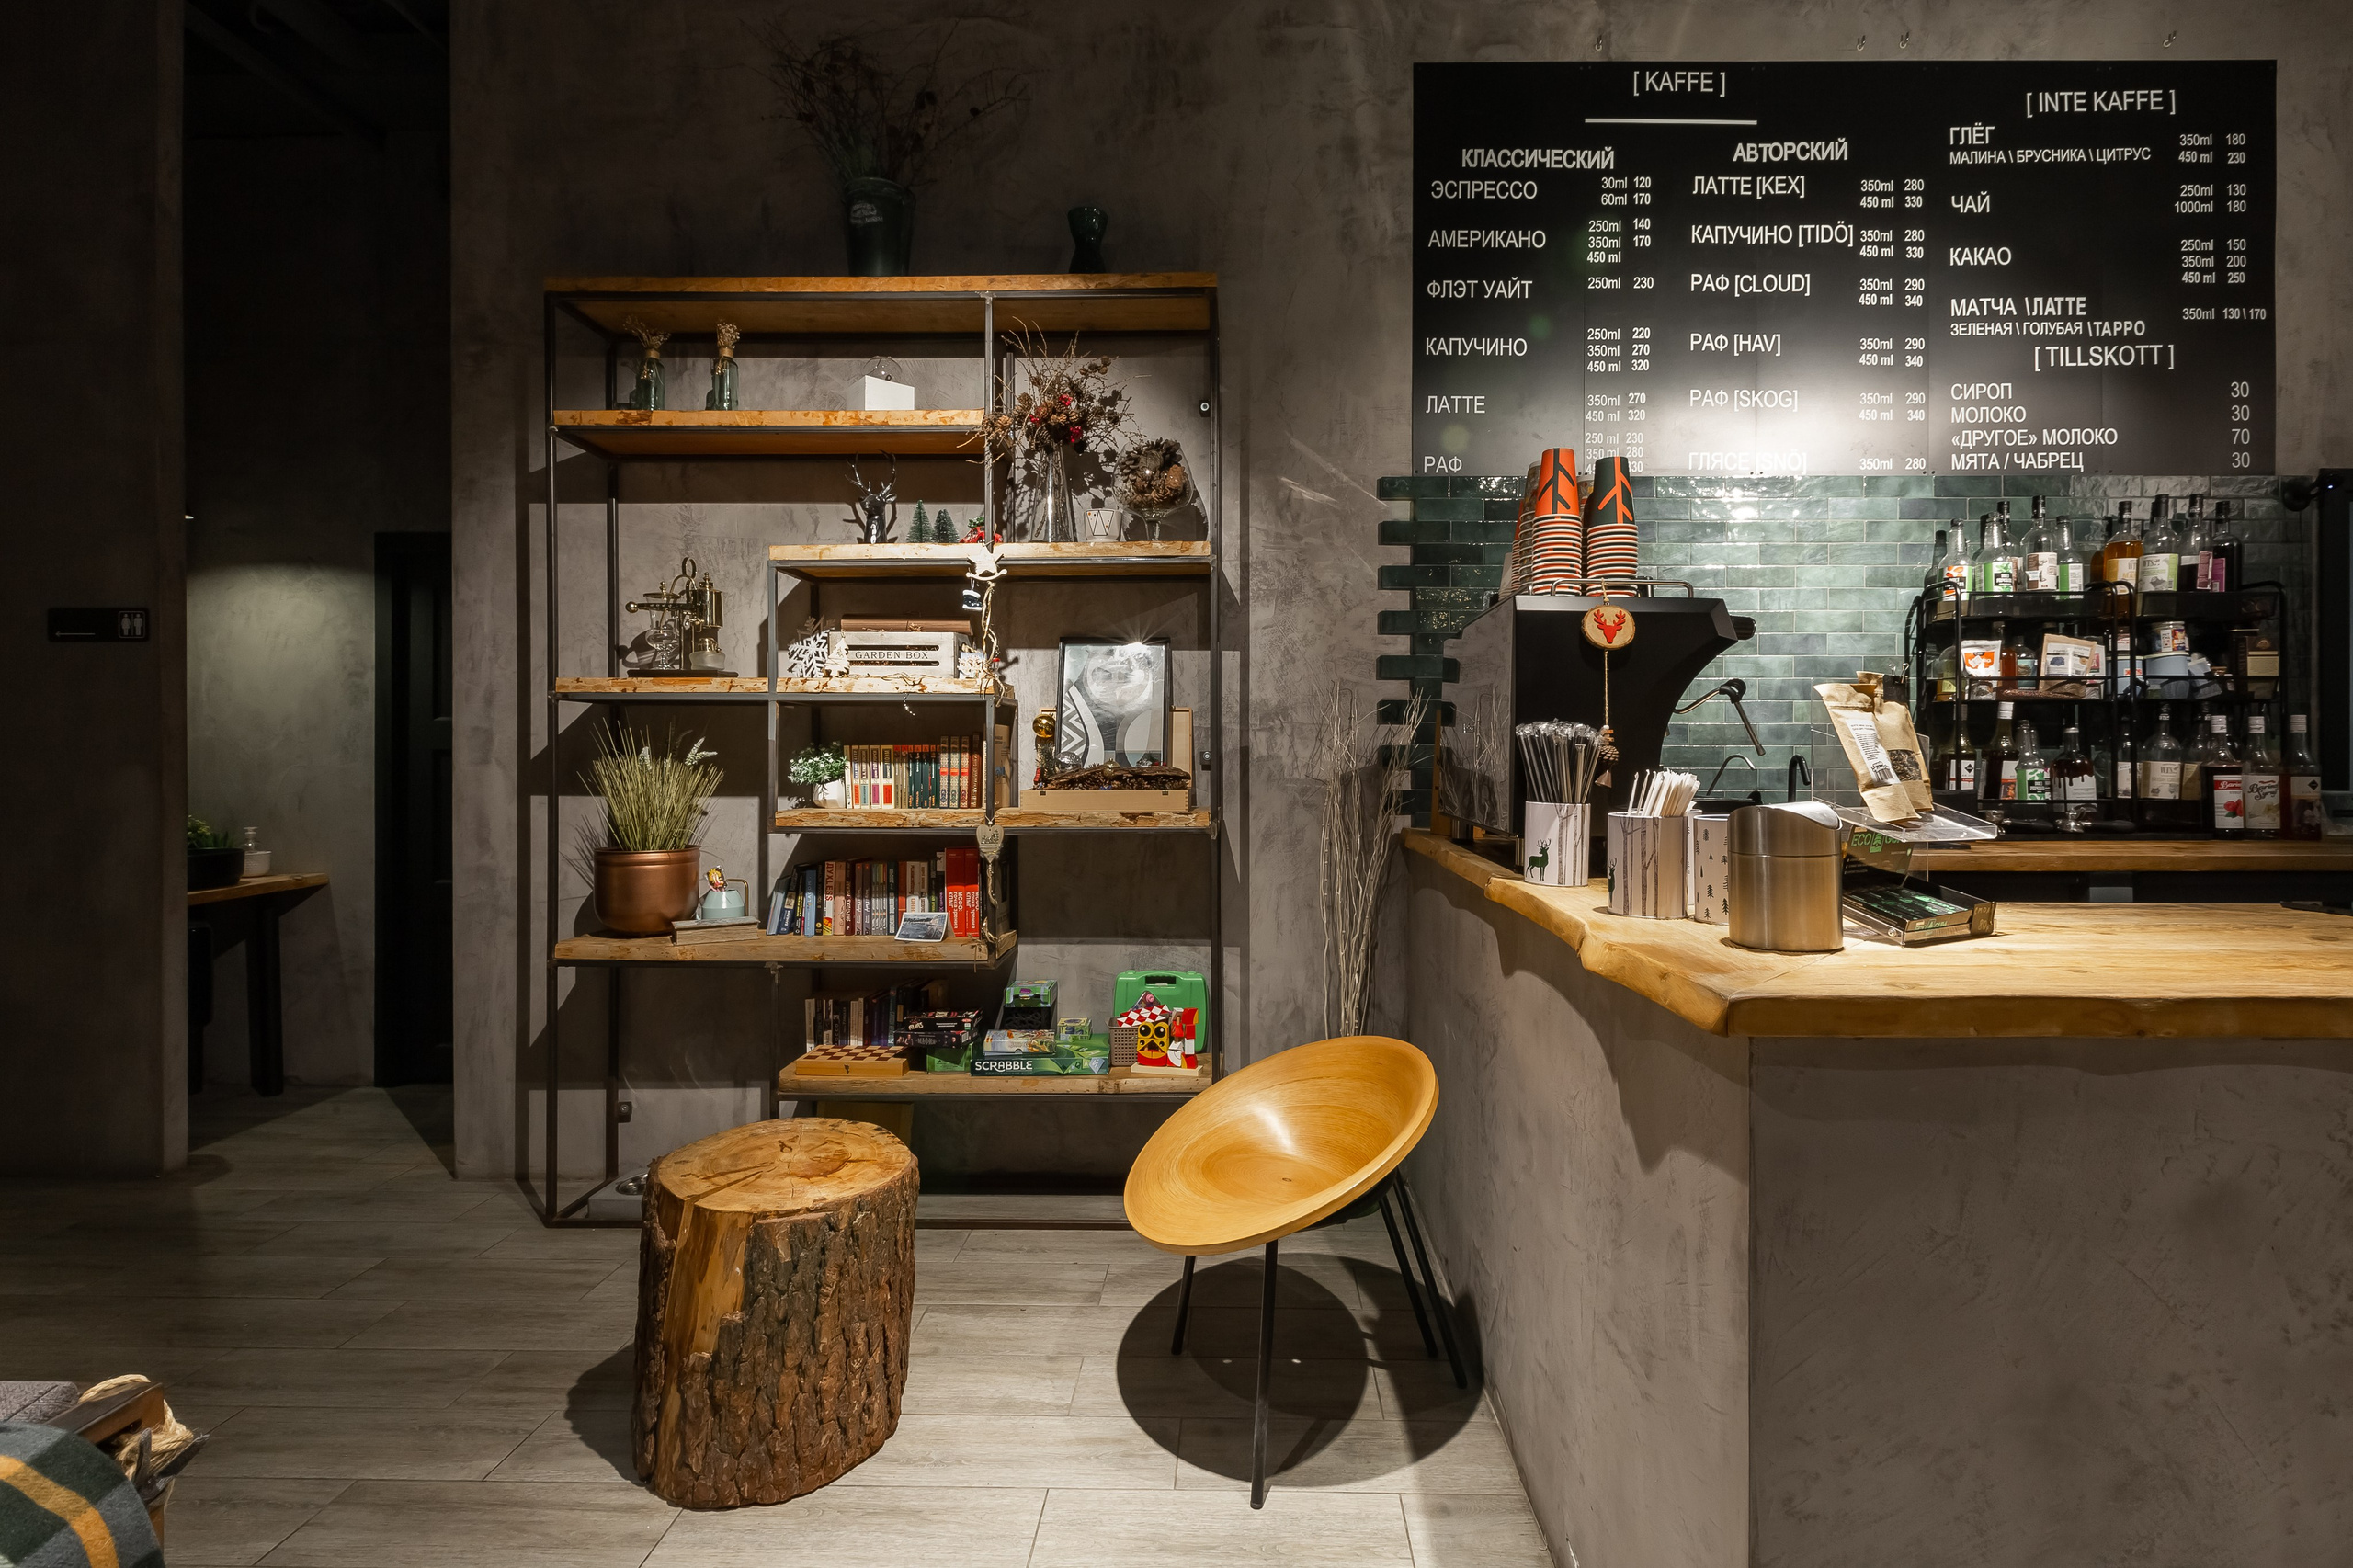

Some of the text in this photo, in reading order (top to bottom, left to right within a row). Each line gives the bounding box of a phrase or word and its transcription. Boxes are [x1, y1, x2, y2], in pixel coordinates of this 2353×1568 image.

[1645, 71, 1713, 92] KAFFE
[2040, 92, 2087, 112] INTE
[2094, 91, 2164, 111] KAFFE
[1949, 122, 1995, 144] ГЛЁГ
[2180, 133, 2245, 146] 350ml 180
[1733, 138, 1848, 163] АВТОРСКИЙ
[1949, 152, 2006, 164] МАЛИНА
[2017, 150, 2086, 163] БРУСНИКА
[2097, 147, 2151, 164] ЦИТРУС
[1461, 146, 1615, 169] КЛАССИЧЕСКИЙ
[2178, 152, 2245, 164] 450 ml 230
[1601, 177, 1651, 189] 30ml 120
[1693, 176, 1805, 199] ЛАТТЕ [KEX]
[1860, 179, 1924, 191] 350ml 280
[1431, 181, 1537, 199] ЭСПРЕССО
[2180, 185, 2246, 197] 250ml 130
[1601, 193, 1651, 205] 60ml 170
[1860, 196, 1923, 208] 450 ml 330
[1951, 191, 1991, 213] ЧАЙ
[2175, 200, 2246, 213] 1000ml 180
[1588, 218, 1650, 232] 250ml 140
[1428, 230, 1546, 248] АМЕРИКАНО
[1691, 221, 1854, 247] КАПУЧИНО [TIDÖ]
[1860, 230, 1925, 242] 350ml 280
[1588, 235, 1651, 248] 350ml 170
[2180, 239, 2246, 251] 250ml 150
[1587, 251, 1621, 263] 450 ml
[1859, 245, 1924, 258] 450 ml 330
[1949, 247, 2012, 266] КАКАО
[2181, 256, 2246, 267] 350ml 200
[1588, 277, 1654, 289] 250ml 230
[1859, 278, 1925, 290] 350ml 290
[2182, 272, 2245, 284] 450 ml 250
[1427, 277, 1532, 299] ФЛЭТ УАЙТ
[1690, 274, 1810, 297] РАФ [CLOUD]
[1859, 294, 1923, 307] 450 ml 340
[1951, 297, 2017, 316] МАТЧА
[2182, 308, 2215, 320] 350ml
[2222, 308, 2240, 319] 130
[2249, 309, 2266, 320] 170
[1587, 327, 1650, 340] 250ml 220
[1950, 323, 2012, 336] ЗЕЛЕНАЯ
[2023, 321, 2083, 335] ГОЛУБАЯ
[1426, 338, 1528, 356] КАПУЧИНО
[1587, 344, 1650, 357] 350ml 270
[1690, 334, 1780, 356] РАФ [HAV]
[1859, 338, 1925, 350] 350ml 290
[1859, 354, 1923, 367] 450 ml 340
[2045, 345, 2163, 367] TILLSKOTT
[1587, 360, 1649, 372] 450 ml 320
[1951, 383, 2012, 400] СИРОП
[2231, 381, 2249, 398] 30
[1426, 396, 1485, 414] ЛАТТЕ
[1587, 393, 1646, 406] 350ml 270
[1689, 390, 1798, 412] РАФ [SKOG]
[1859, 393, 1925, 404] 350ml 290
[1586, 410, 1645, 422] 450 ml 320
[1859, 409, 1925, 421] 450 ml 340
[1951, 406, 2027, 424] МОЛОКО
[2231, 405, 2250, 421] 30
[1586, 432, 1643, 444] 250 ml 230
[1951, 427, 2118, 449] «ДРУГОЕ» МОЛОКО
[2232, 428, 2250, 445] 70
[1626, 447, 1643, 458] 280
[1424, 456, 1462, 473] РАФ
[1859, 458, 1926, 470] 350ml 280
[1951, 454, 2000, 470] МЯТА
[2013, 452, 2084, 472] ЧАБРЕЦ
[2232, 452, 2250, 468] 30
[855, 651, 929, 660] GARDEN BOX
[1850, 833, 1872, 846] ECO
[975, 1060, 1033, 1073] SCRABBLE
